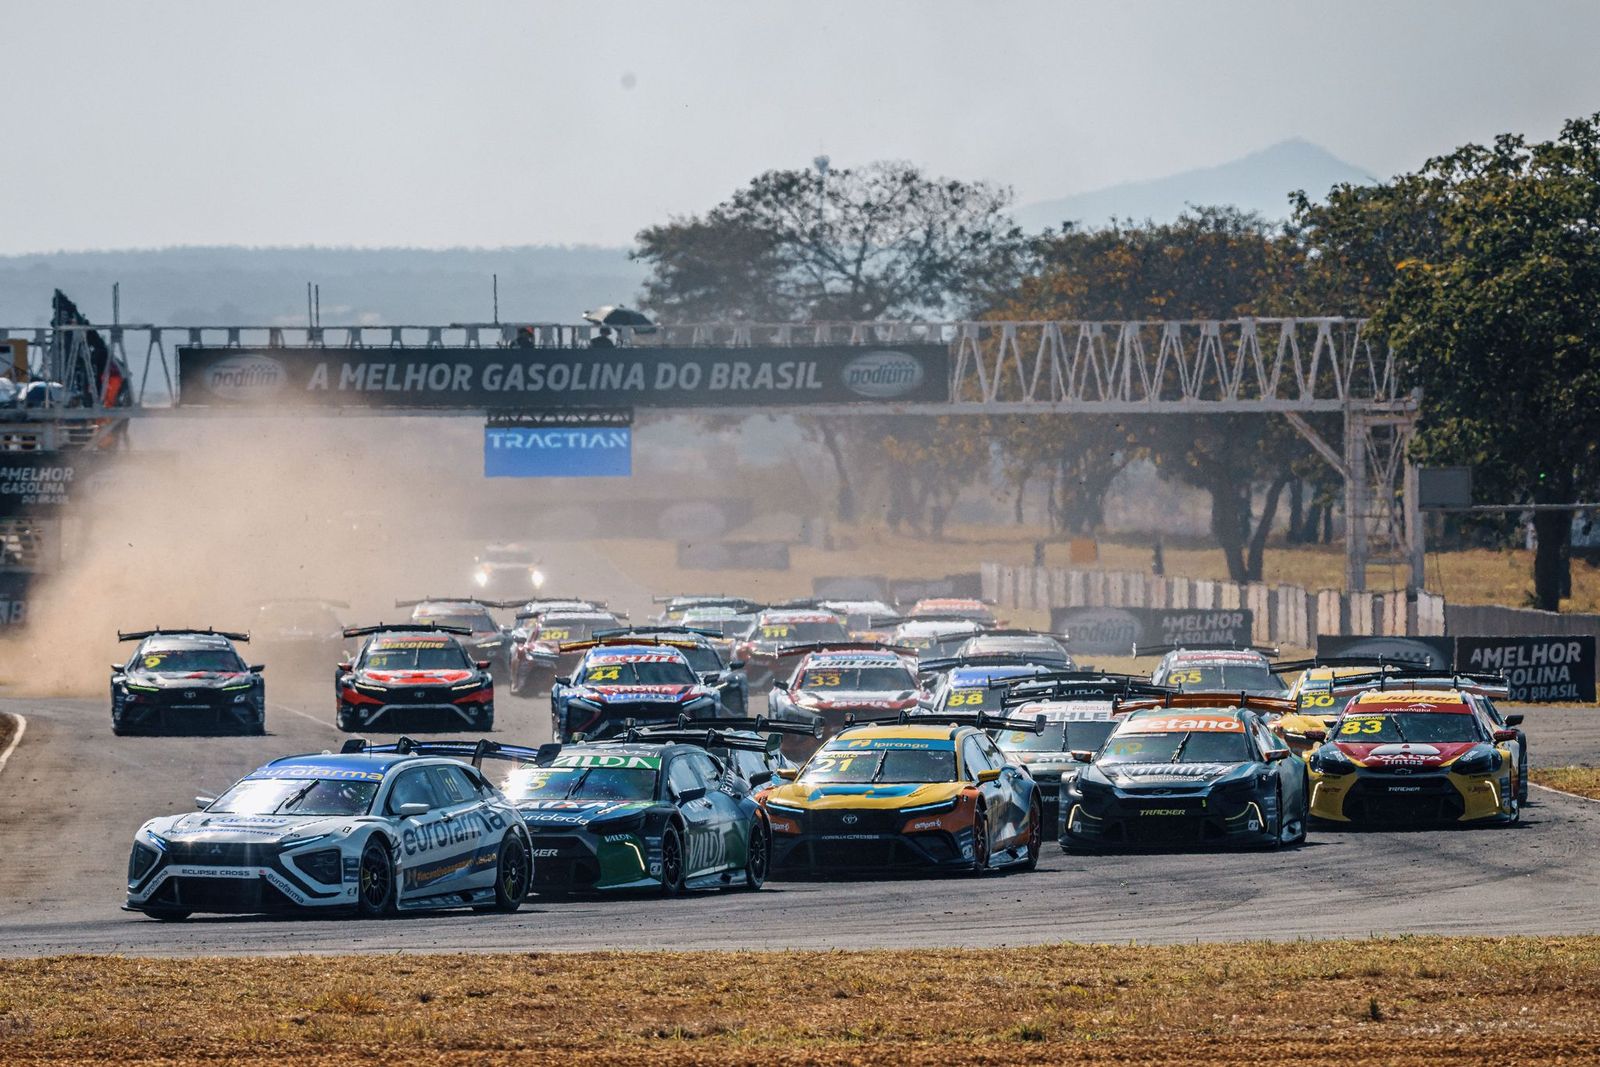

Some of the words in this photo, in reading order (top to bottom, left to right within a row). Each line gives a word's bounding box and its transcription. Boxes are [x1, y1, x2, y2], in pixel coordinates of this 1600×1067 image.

[307, 363, 329, 391] A
[338, 363, 474, 392] MELHOR
[481, 363, 646, 392] GASOLINA
[654, 362, 702, 390] DO
[708, 361, 824, 391] BRASIL
[488, 432, 628, 449] TRACTIAN
[1, 482, 65, 494] GASOLINA
[1481, 642, 1581, 669] MELHOR
[589, 670, 620, 680] 44
[808, 675, 841, 687] 33
[1533, 684, 1580, 699] BRASIL
[947, 694, 983, 707] 88
[1301, 696, 1335, 708] 30
[1150, 719, 1240, 729] etano
[1341, 721, 1383, 735] 83
[811, 758, 853, 773] 21
[403, 808, 507, 857] eurofarma
[267, 873, 305, 904] eurofarma
